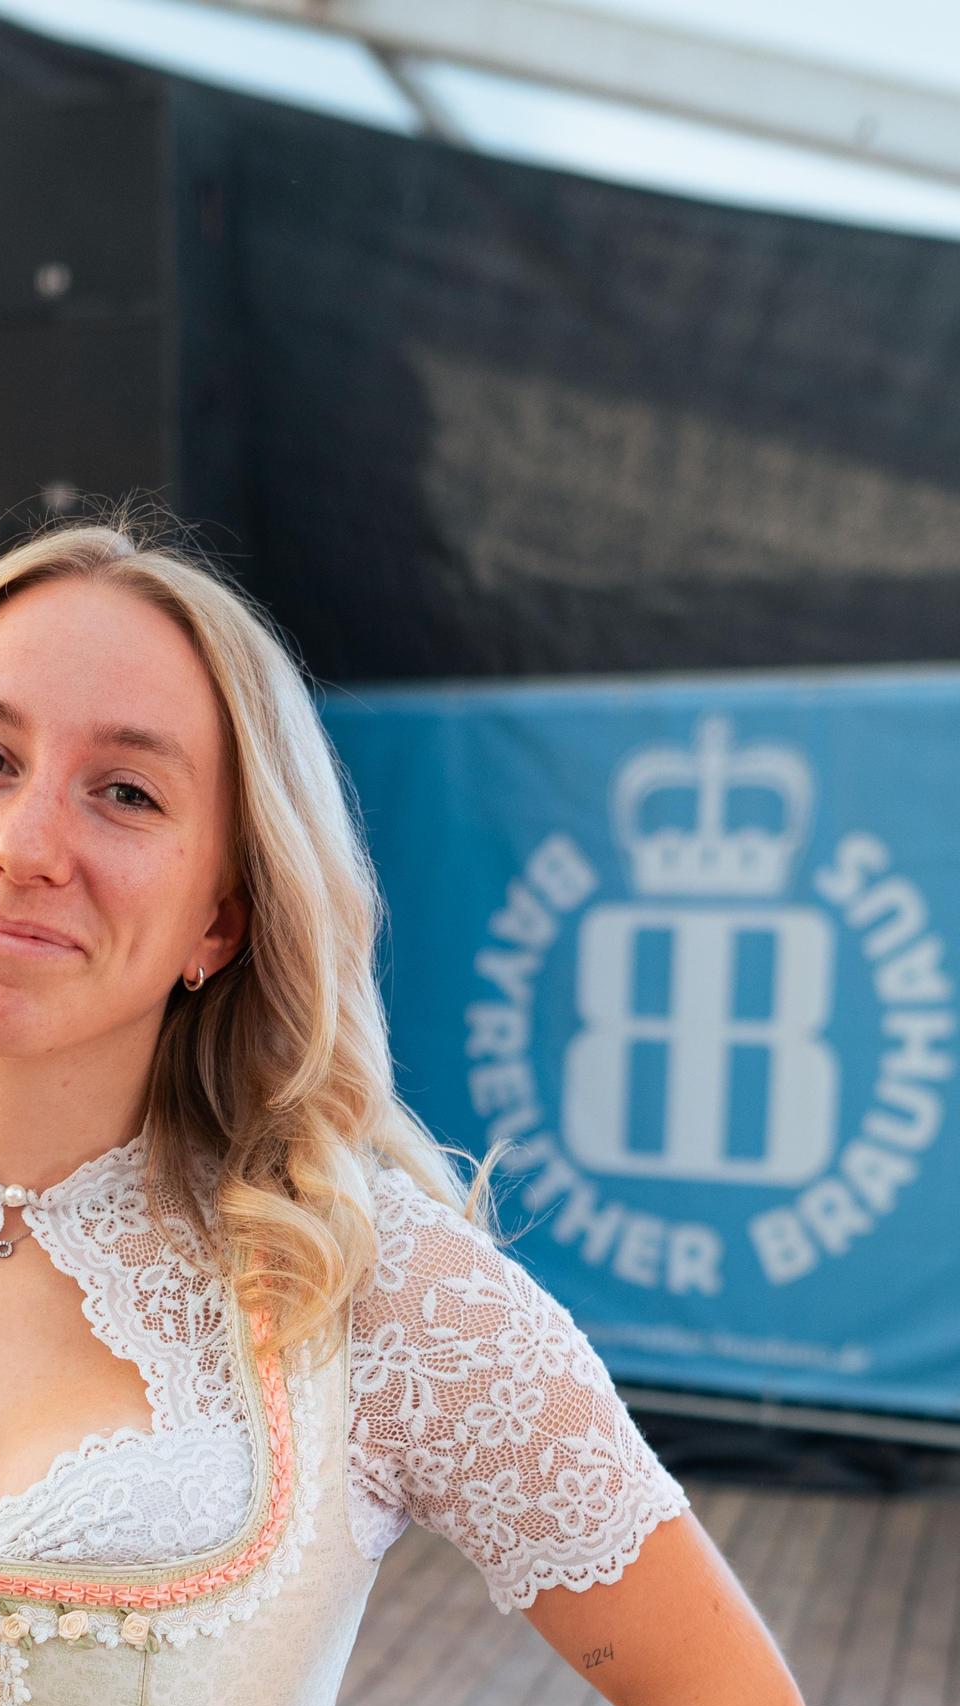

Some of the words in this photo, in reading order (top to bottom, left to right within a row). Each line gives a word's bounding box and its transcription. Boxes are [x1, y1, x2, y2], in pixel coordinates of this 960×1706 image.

[465, 834, 724, 1296] BAYREUTHER
[747, 832, 957, 1286] BRAUHAUS
[582, 1641, 615, 1669] 224
